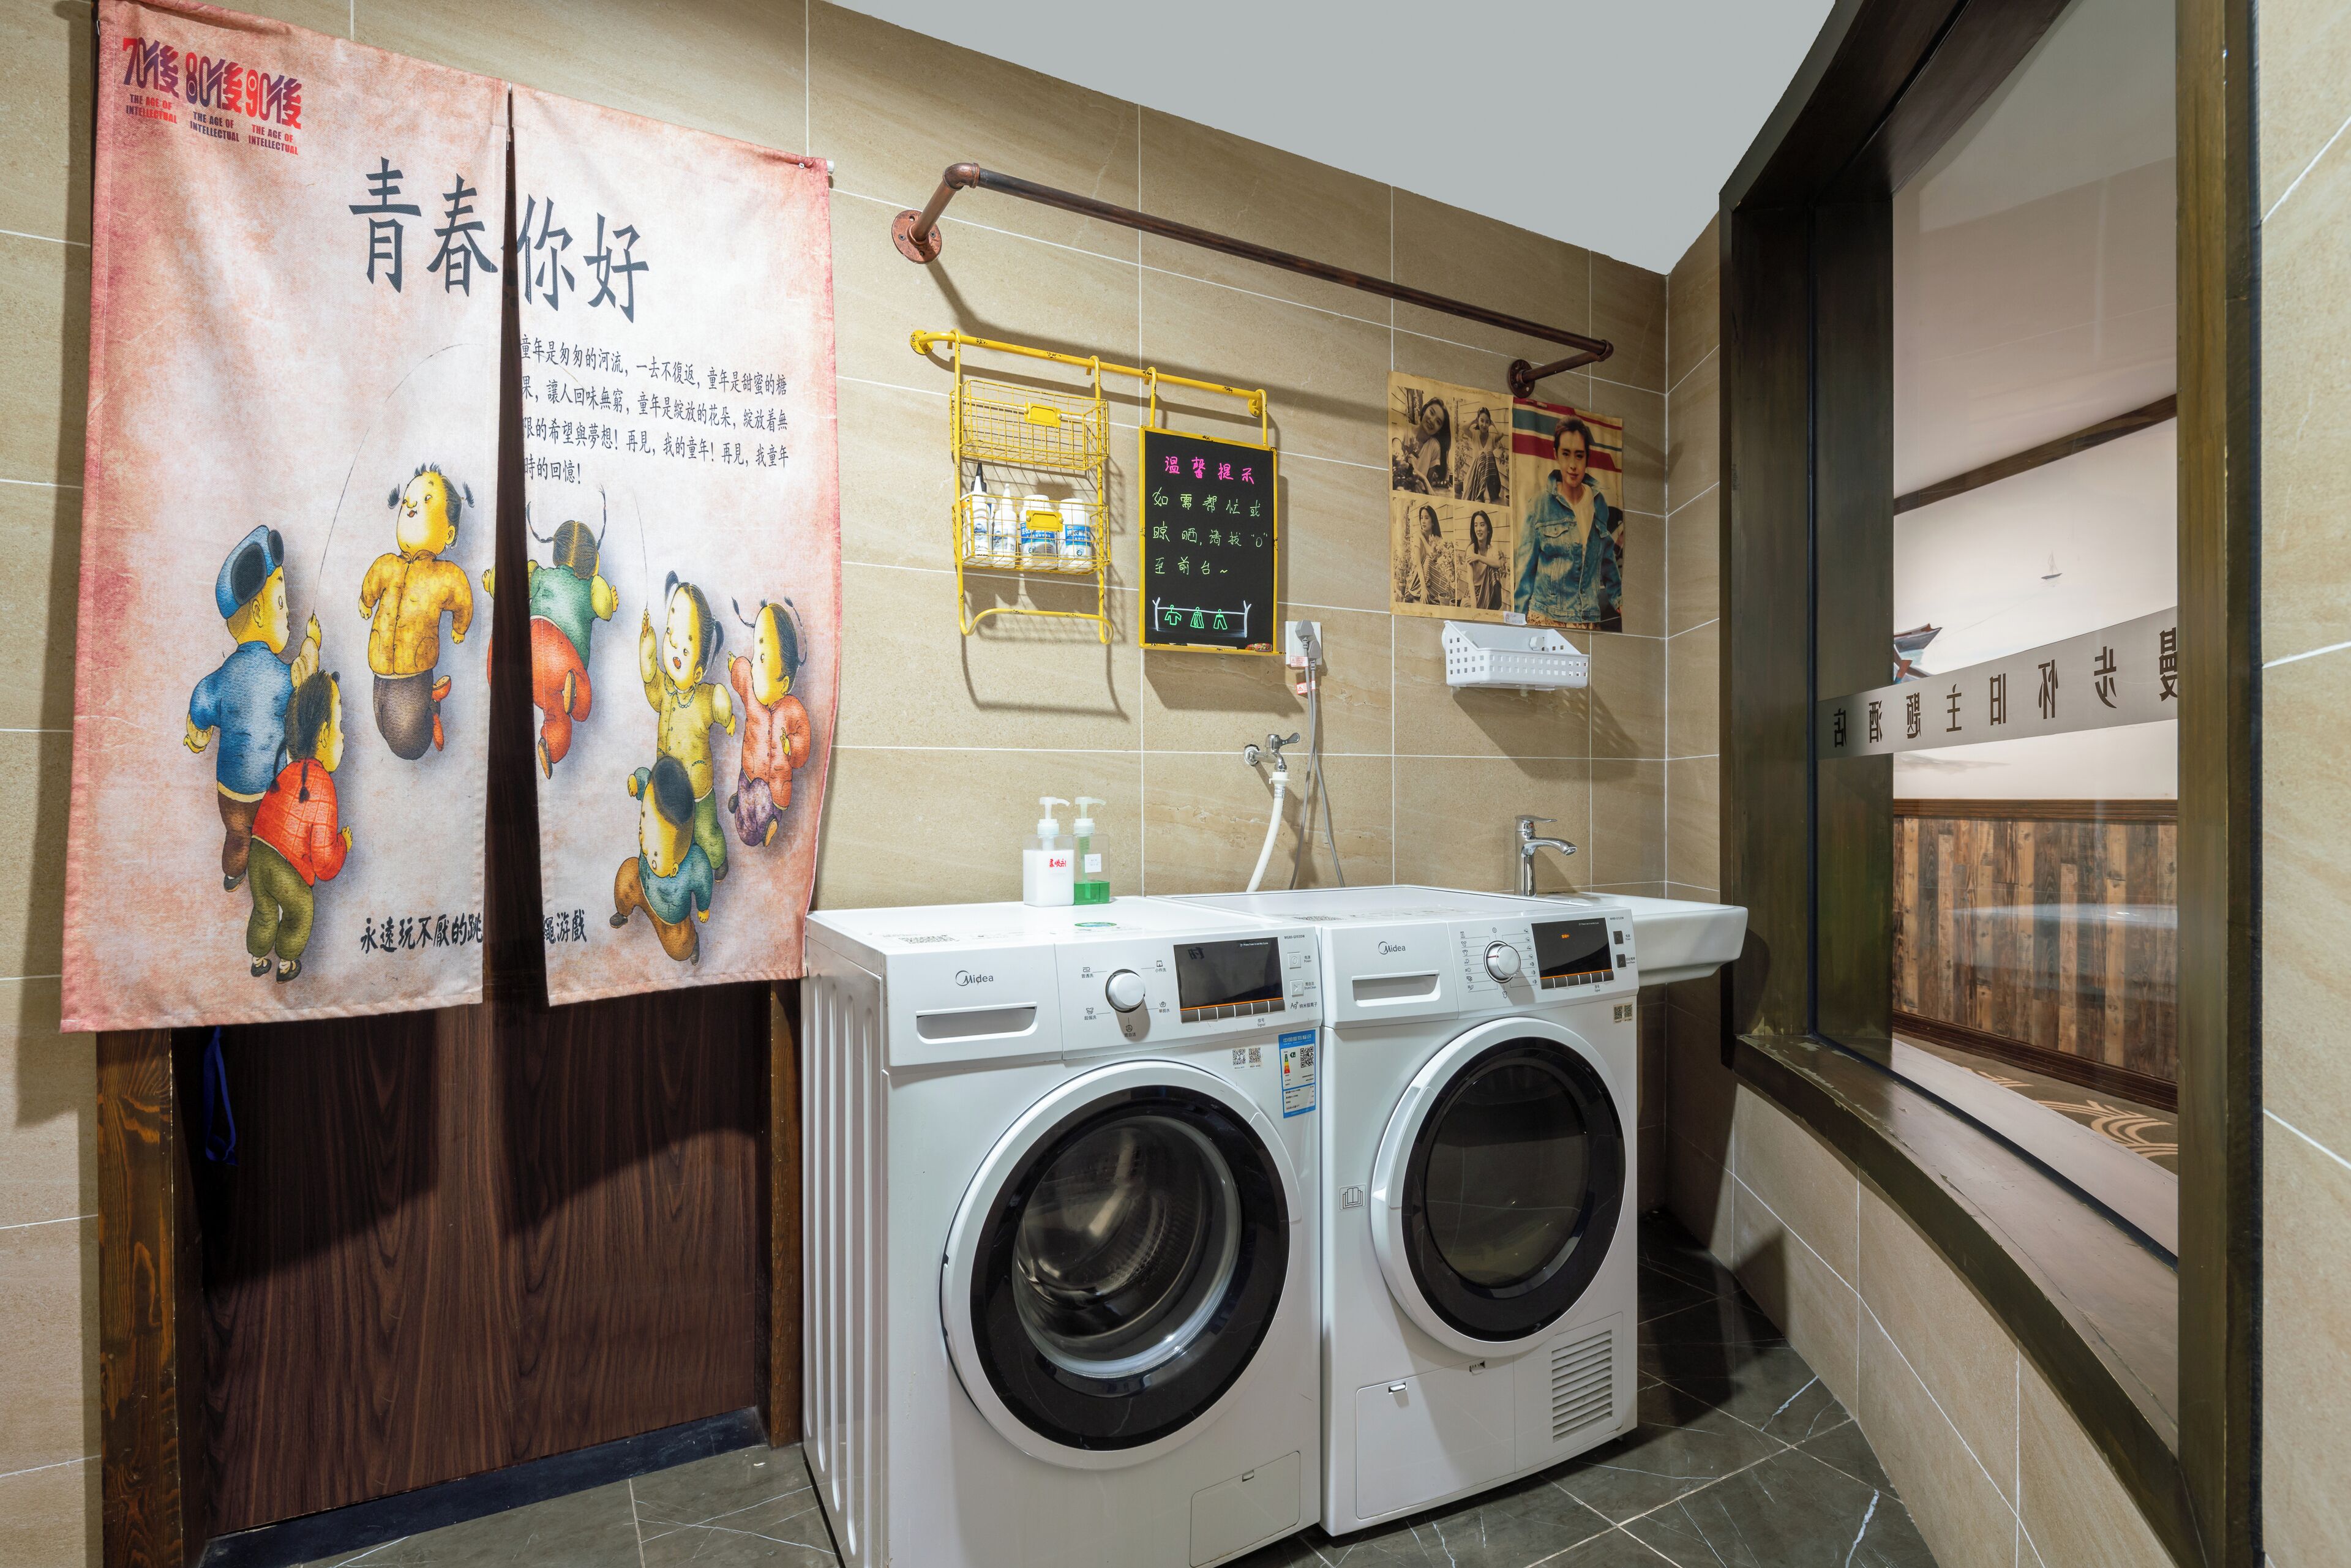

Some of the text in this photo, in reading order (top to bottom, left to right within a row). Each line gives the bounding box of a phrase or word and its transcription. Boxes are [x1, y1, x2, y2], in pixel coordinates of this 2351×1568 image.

[130, 94, 172, 110] THE AGE OF
[126, 105, 177, 124] INTELLECTUAL
[193, 111, 234, 129] THE AGE OF
[190, 121, 239, 142] INTELLECTUAL
[252, 124, 293, 143] THE AGE OF
[248, 135, 298, 156] INTELLECTUAL
[348, 156, 650, 323] 青春你好
[1164, 456, 1254, 484] 温馨提示
[1152, 487, 1261, 517] 如需帮忙或
[1378, 941, 1406, 955] Midea
[955, 970, 994, 986] Midea
